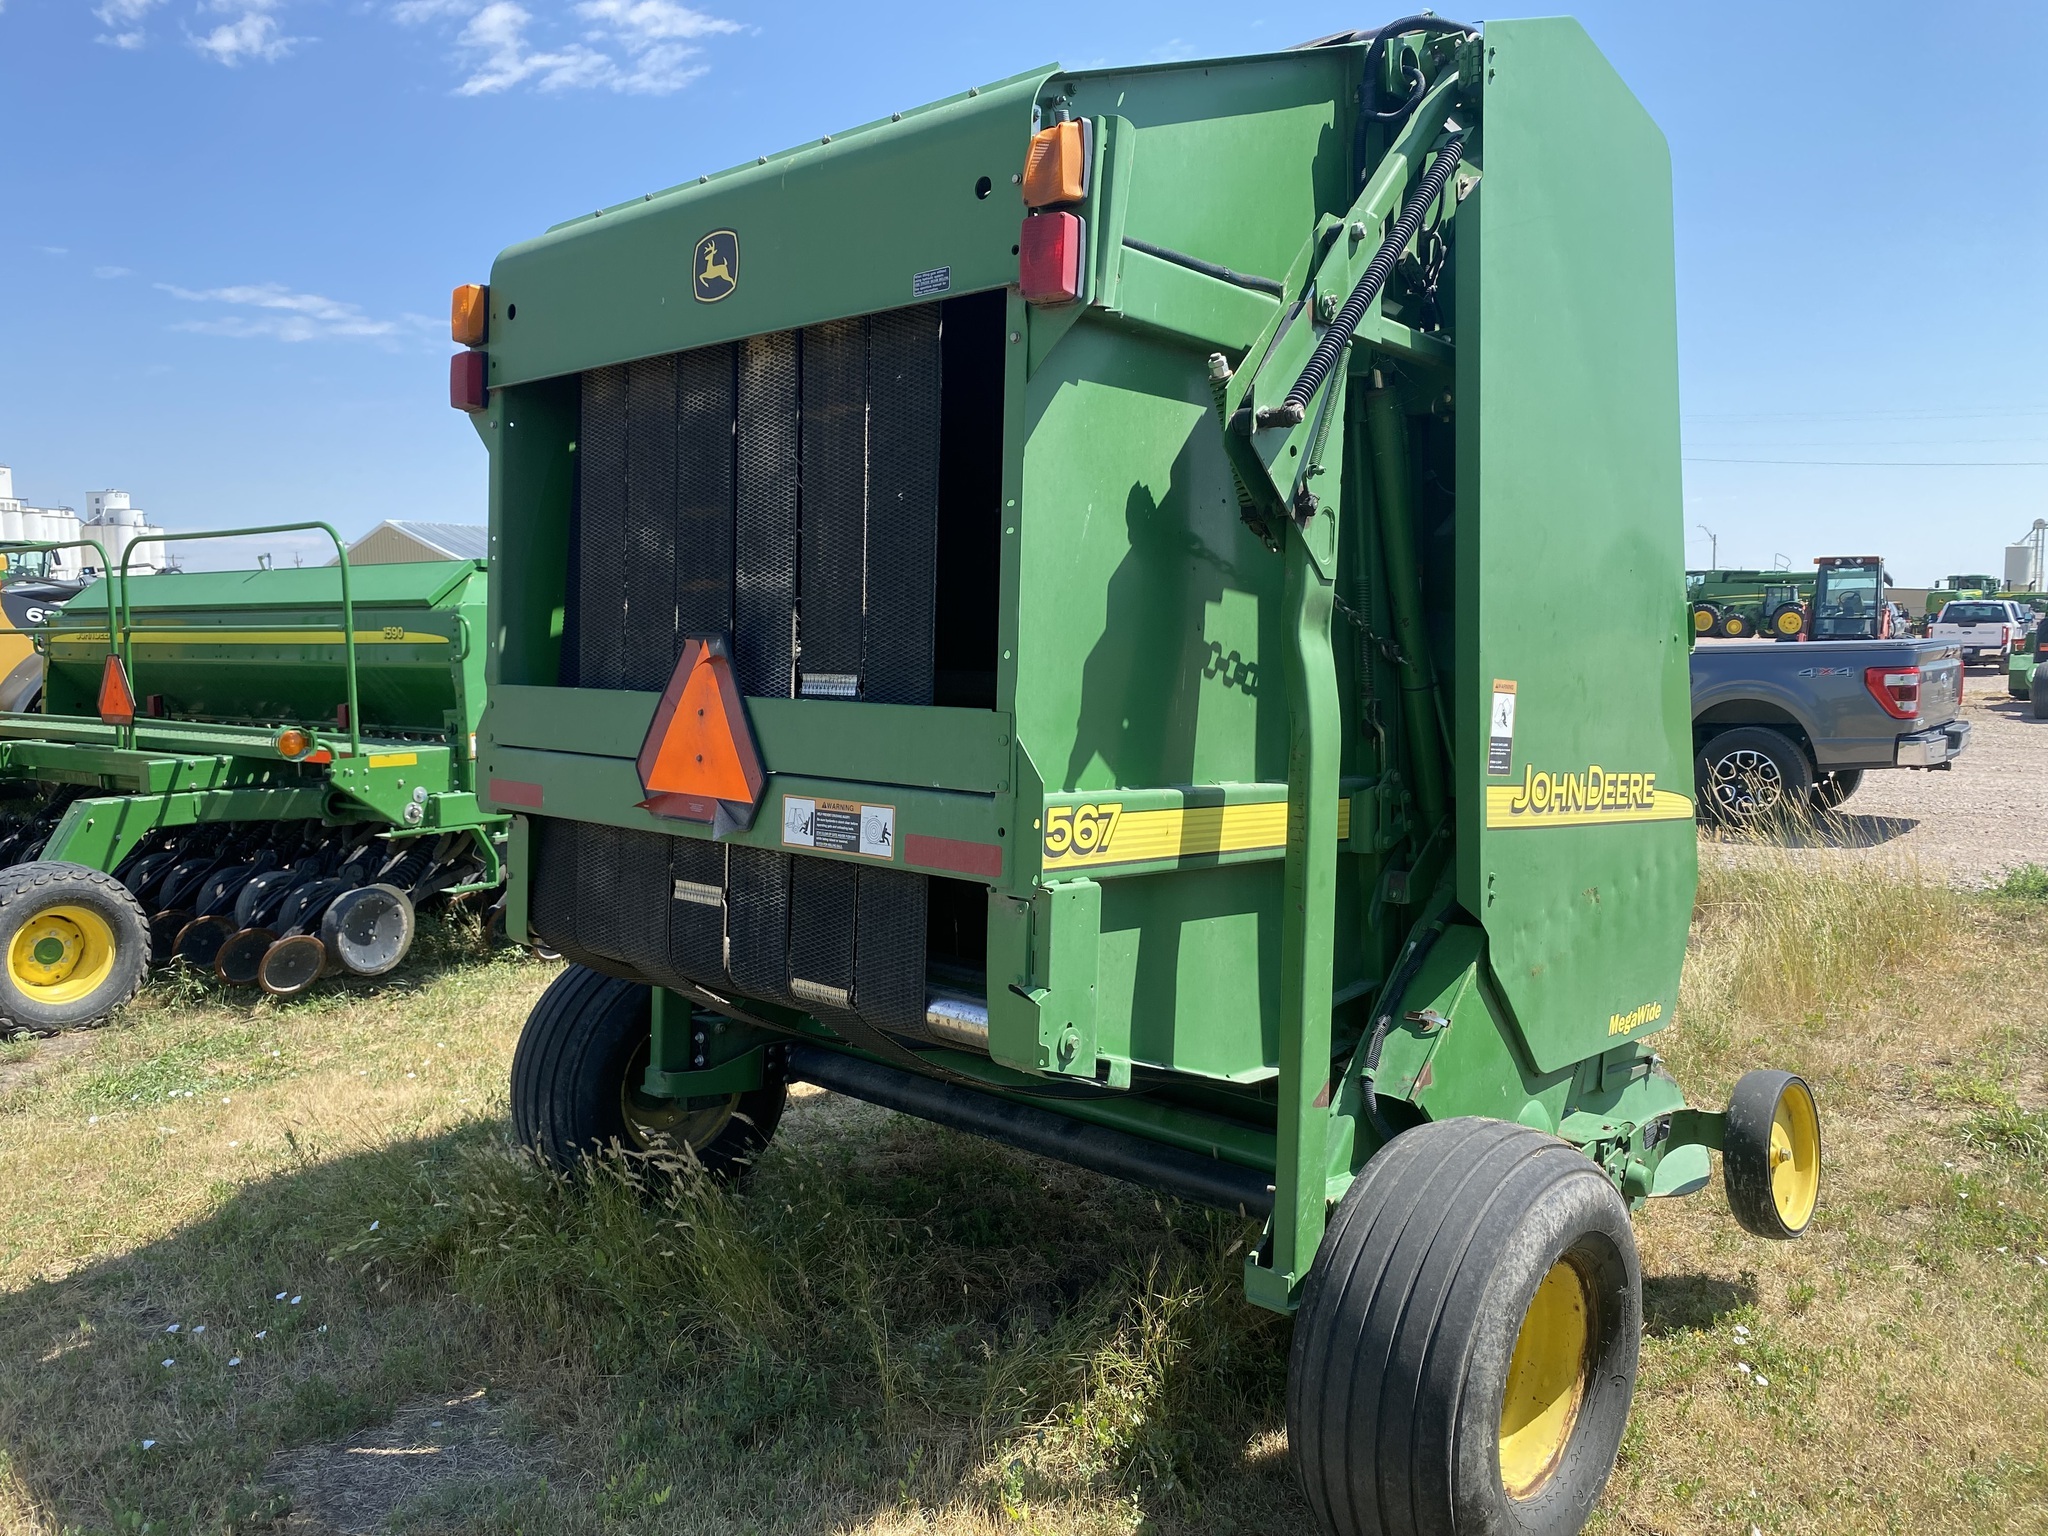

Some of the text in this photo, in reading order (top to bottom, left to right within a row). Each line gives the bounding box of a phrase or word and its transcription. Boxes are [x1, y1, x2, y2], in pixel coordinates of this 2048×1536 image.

[383, 626, 404, 640] 1590
[1511, 763, 1656, 814] JOHN DEERE
[827, 803, 854, 812] WARNING
[1043, 803, 1122, 857] 567
[1608, 1001, 1662, 1036] MegaWide
